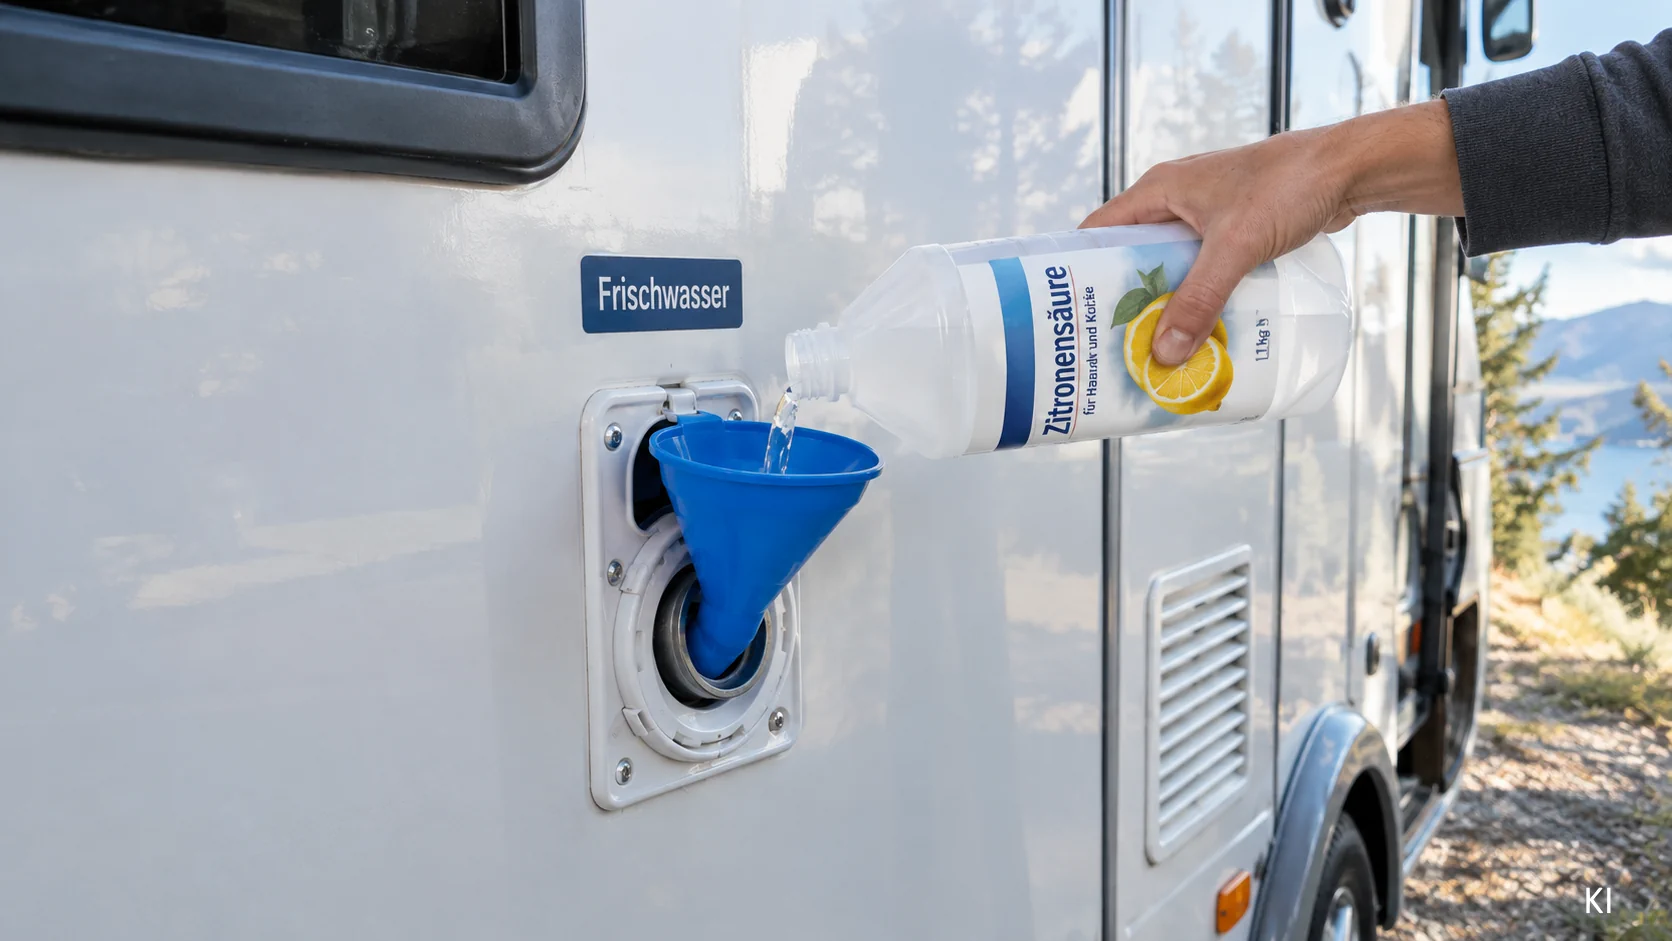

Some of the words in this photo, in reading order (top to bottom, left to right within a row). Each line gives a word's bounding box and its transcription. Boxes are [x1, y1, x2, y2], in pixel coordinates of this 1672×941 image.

[598, 275, 730, 311] Frischwasser
[1042, 265, 1076, 436] Zitronensäure
[1086, 326, 1098, 350] und
